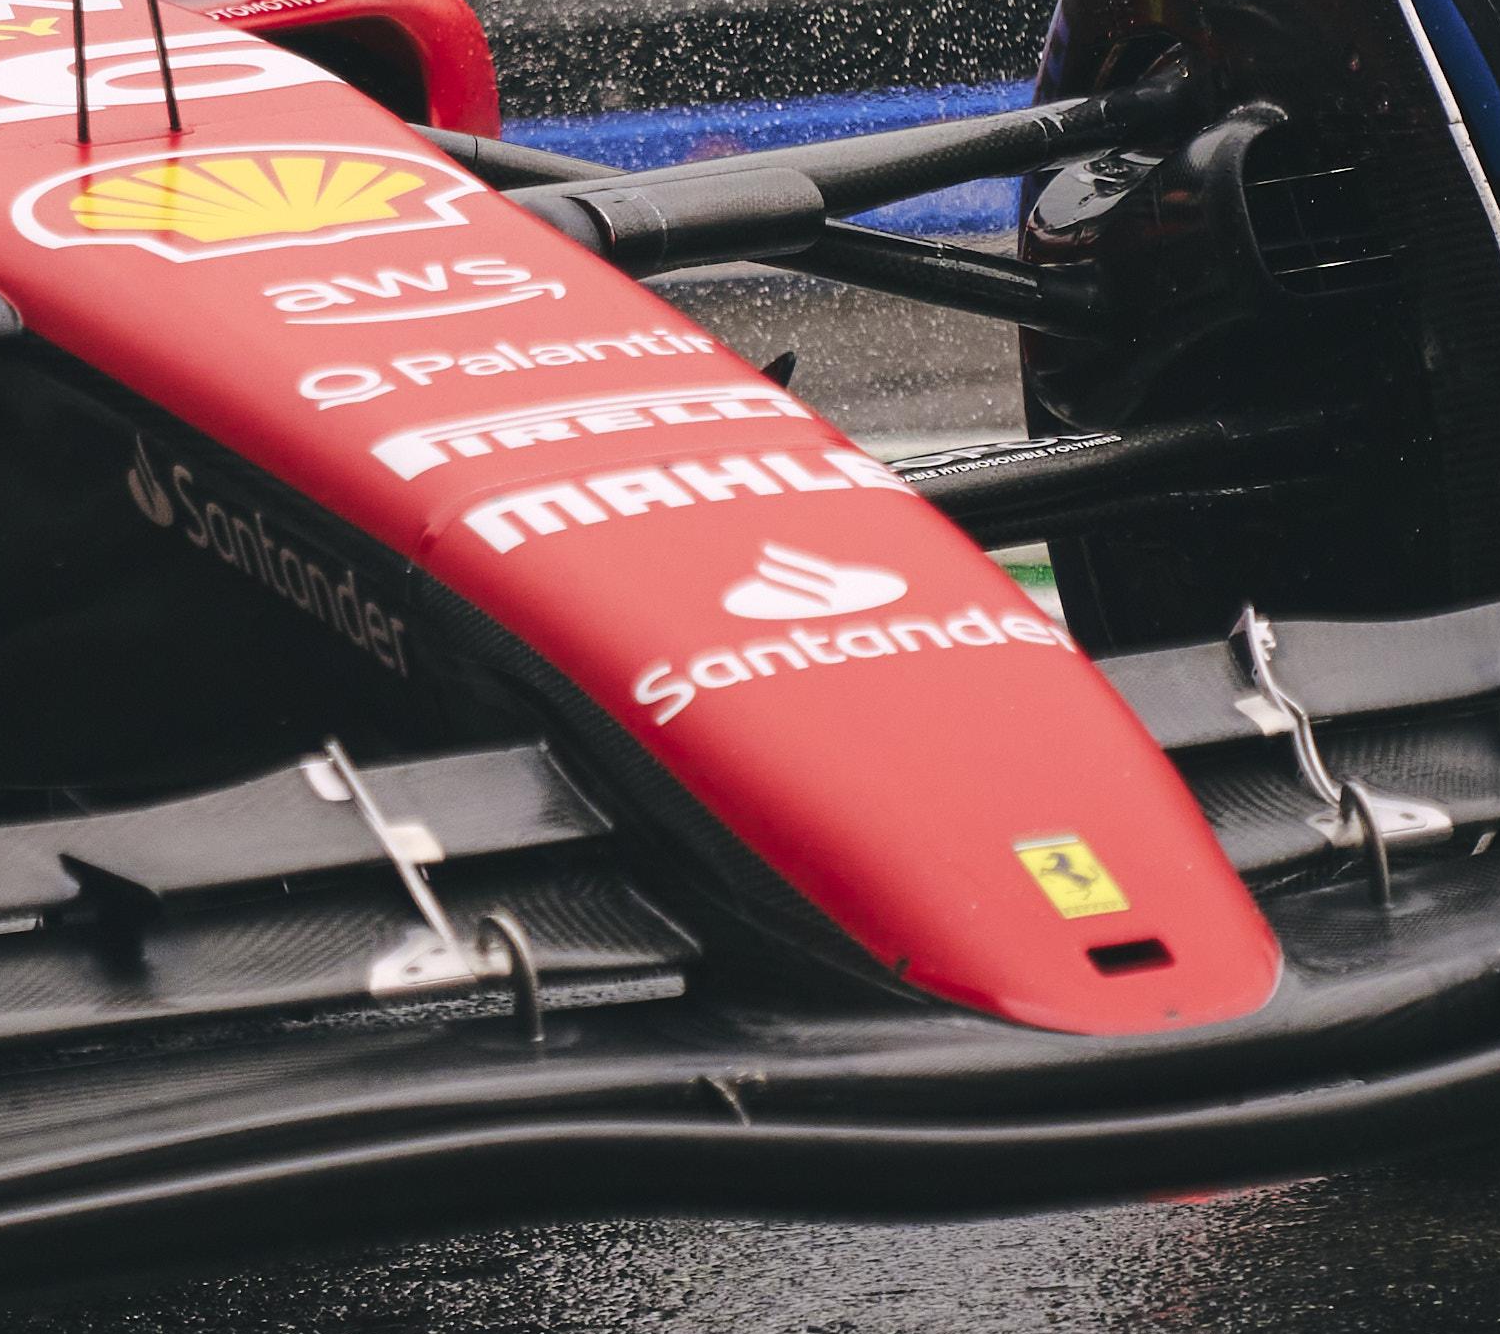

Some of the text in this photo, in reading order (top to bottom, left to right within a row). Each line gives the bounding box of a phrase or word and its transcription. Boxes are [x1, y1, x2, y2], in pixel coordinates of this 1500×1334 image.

[262, 260, 533, 313] aws
[392, 330, 715, 386] Palantir
[370, 384, 813, 481] PIRELLI
[939, 447, 1049, 478] HYDROSOLUBLE
[1050, 433, 1122, 457] POLYMERS
[464, 449, 918, 555] MAHLE
[172, 464, 408, 678] Santander
[633, 606, 1077, 726] Santander
